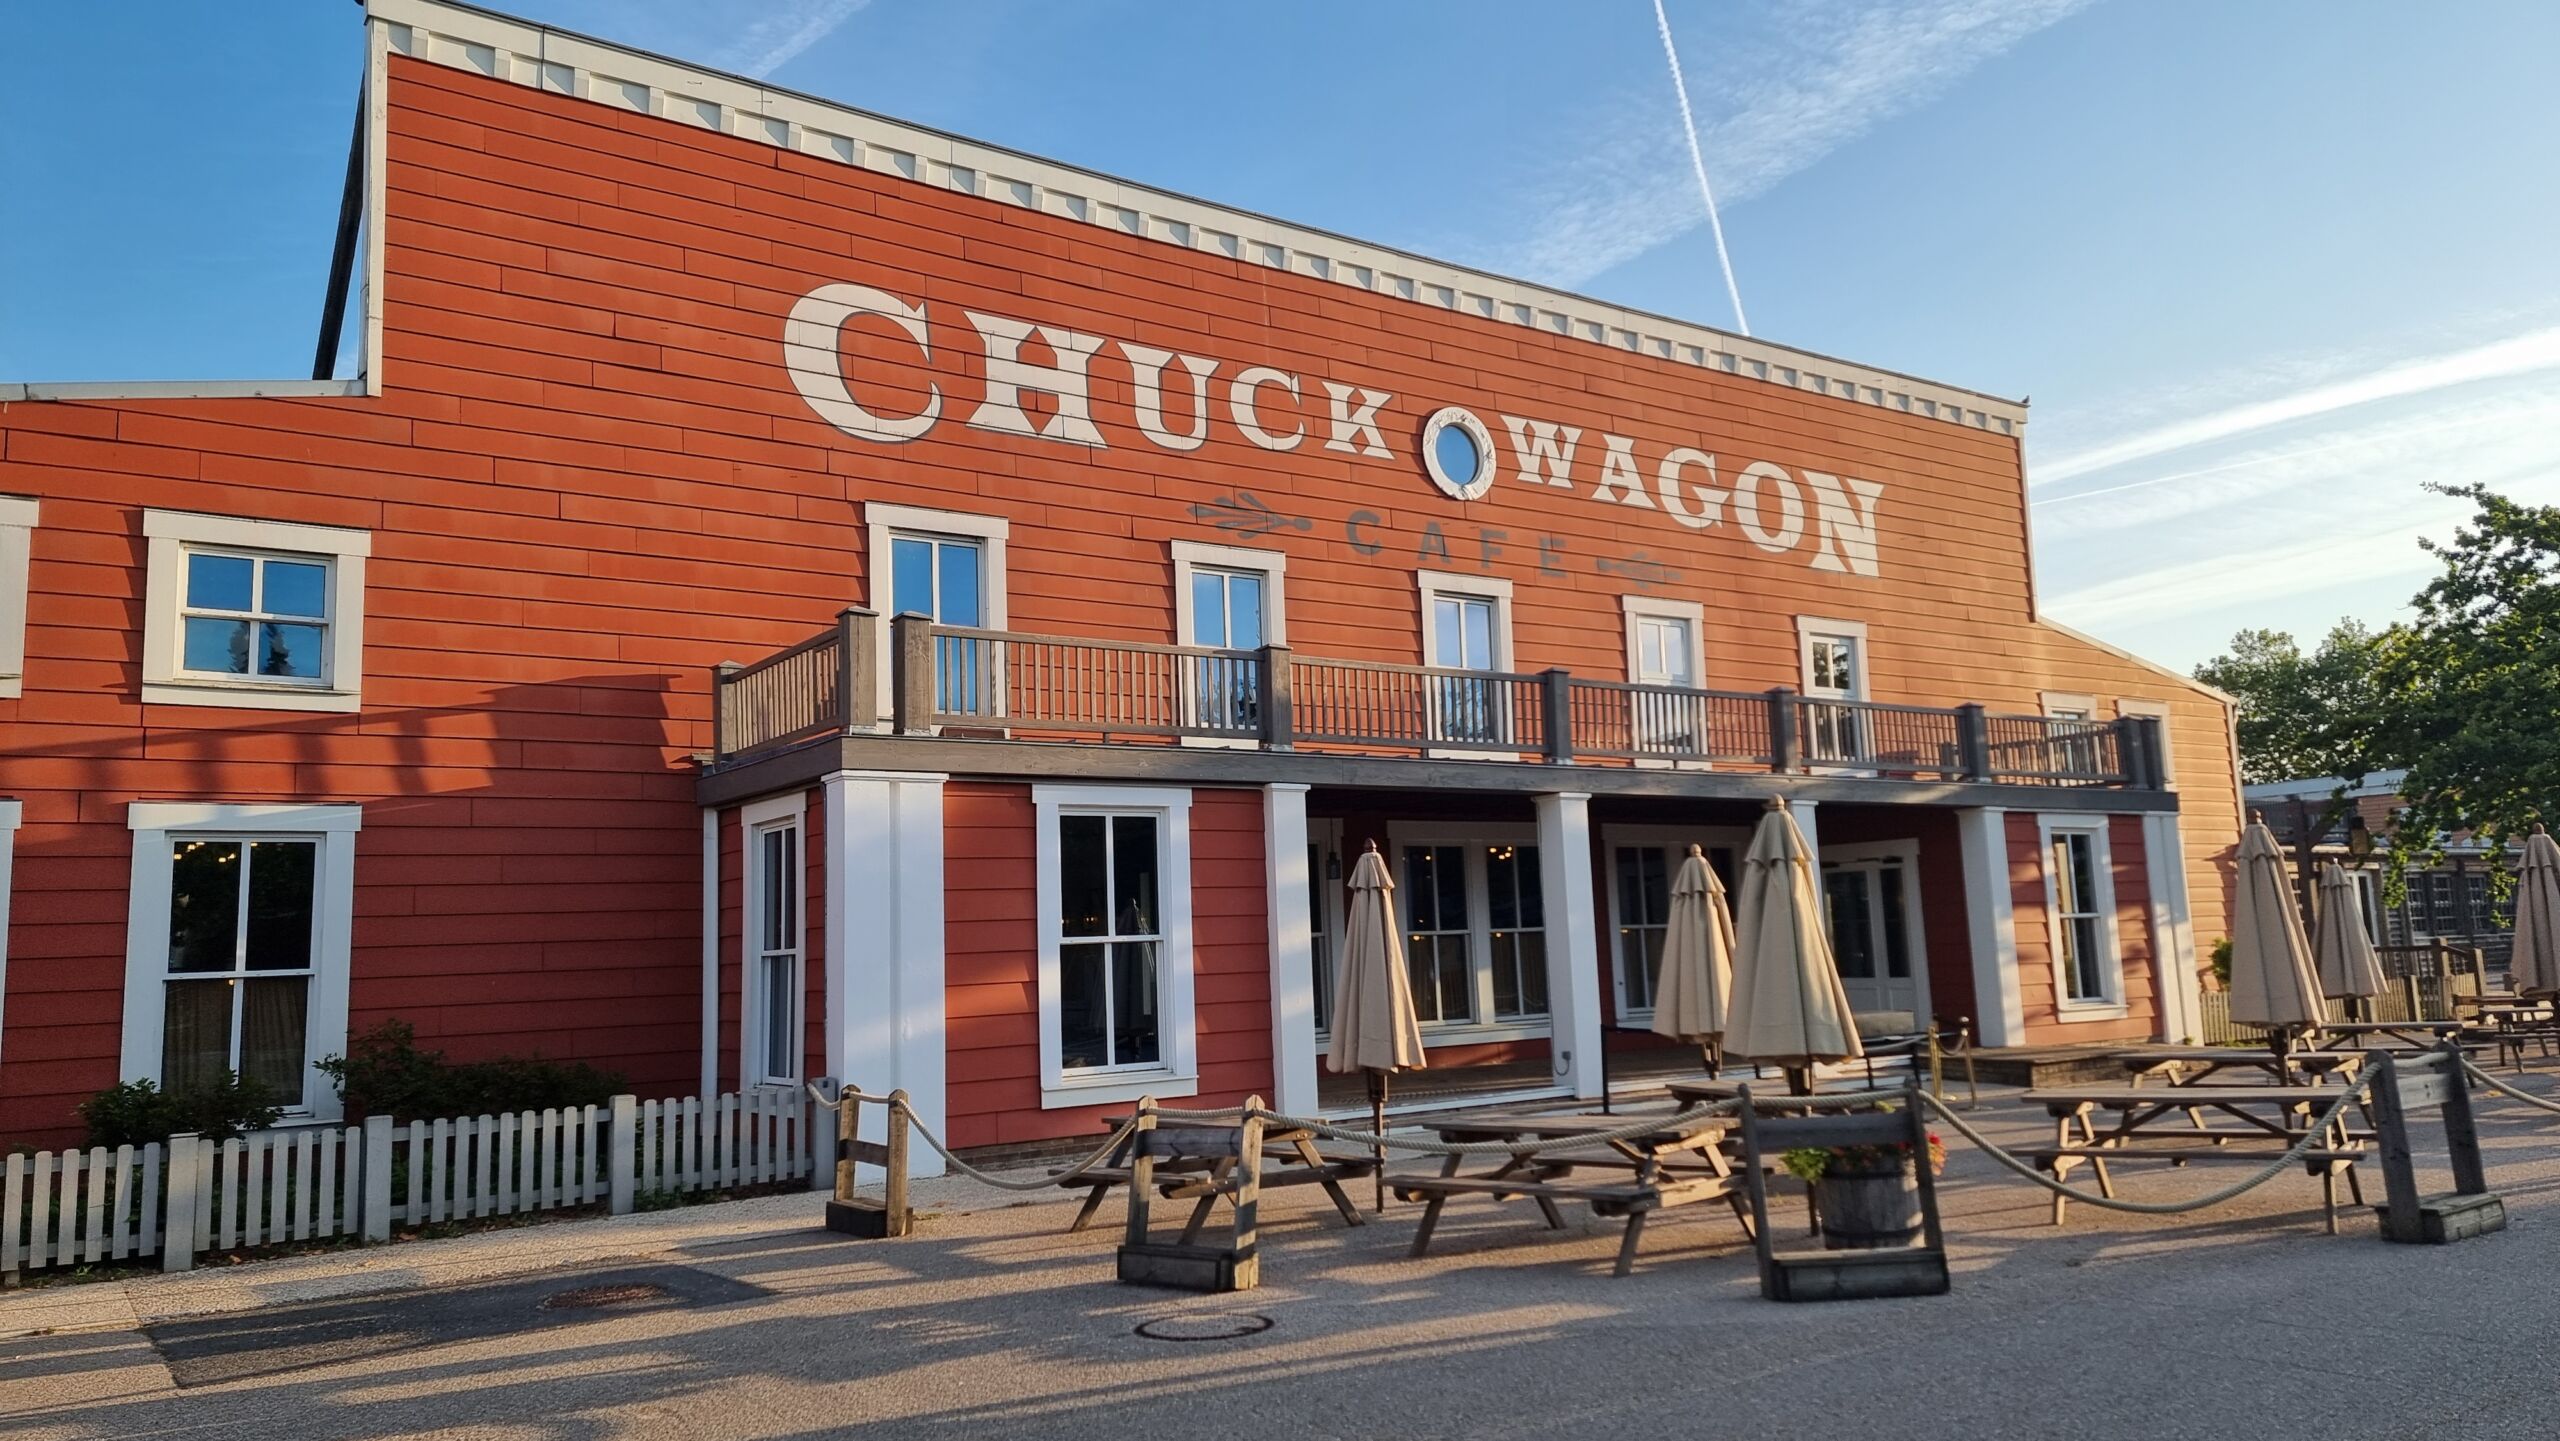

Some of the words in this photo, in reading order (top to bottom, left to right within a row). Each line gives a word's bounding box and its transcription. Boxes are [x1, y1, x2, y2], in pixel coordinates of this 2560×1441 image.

[783, 282, 1395, 460] CHUCK
[1500, 413, 1886, 578] WAGON
[1345, 509, 1567, 578] CAFE
